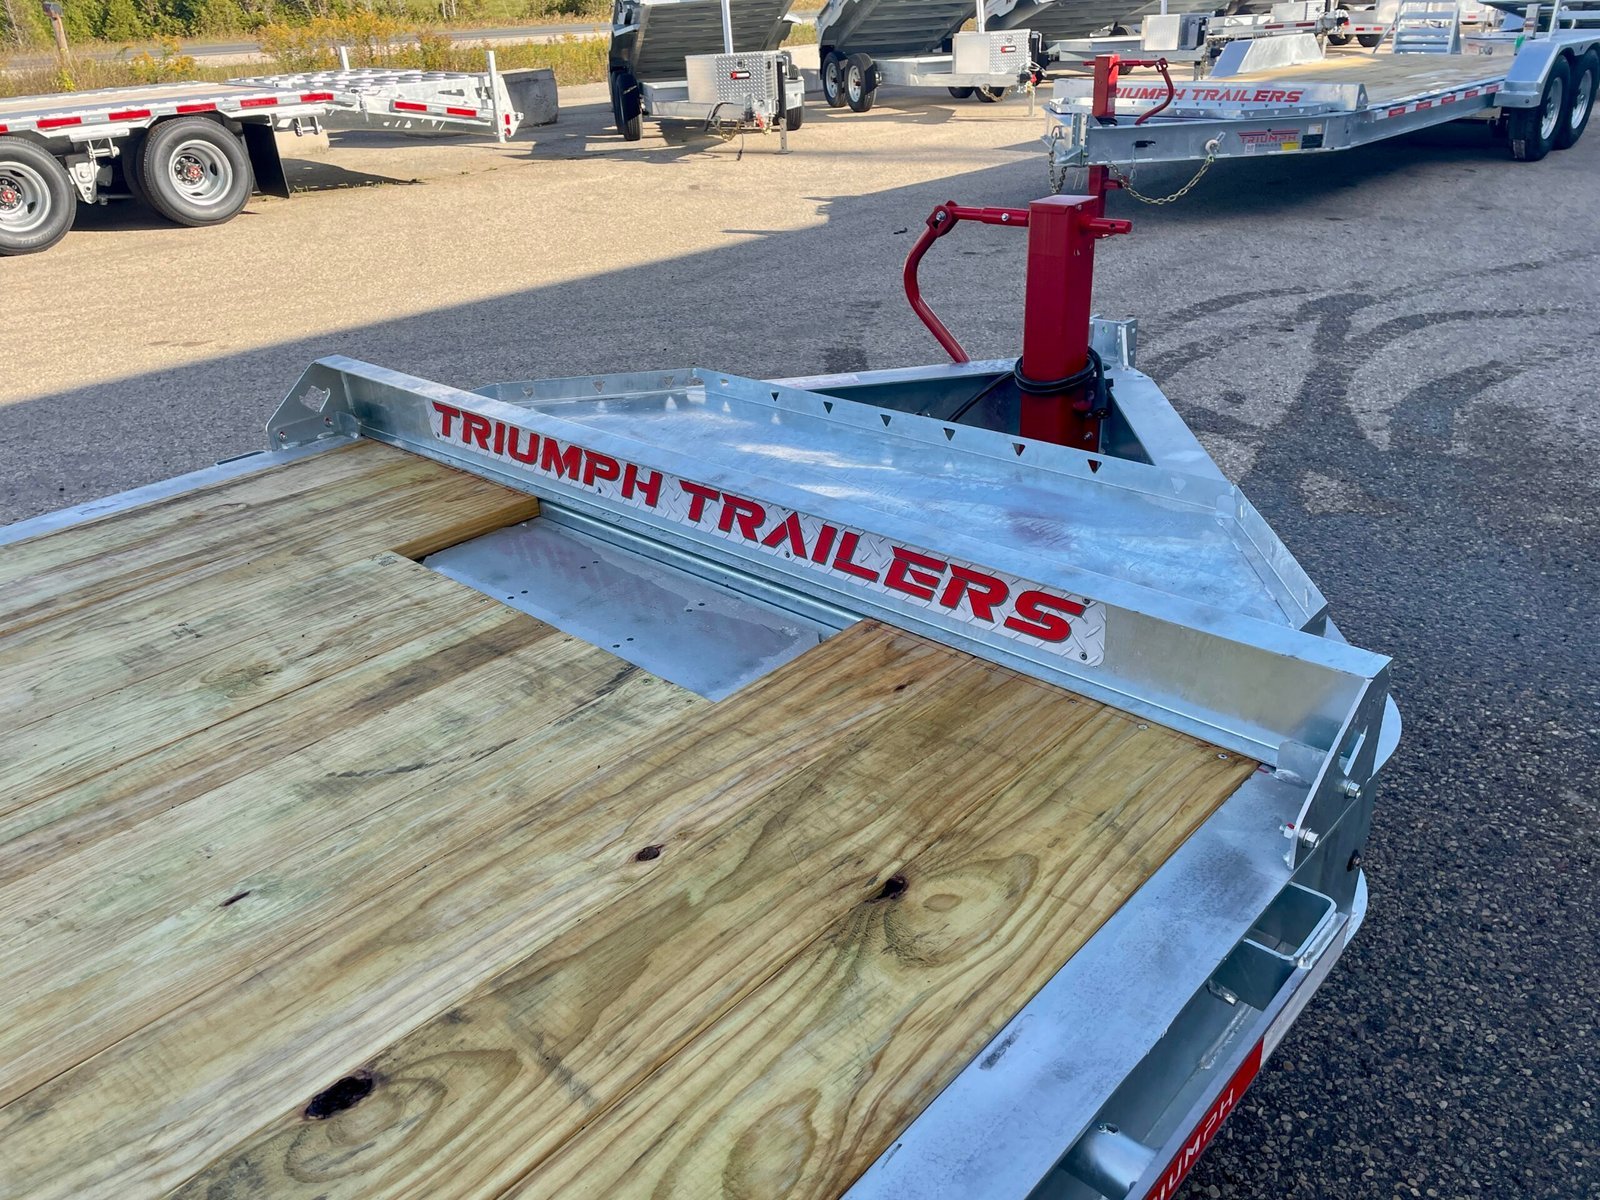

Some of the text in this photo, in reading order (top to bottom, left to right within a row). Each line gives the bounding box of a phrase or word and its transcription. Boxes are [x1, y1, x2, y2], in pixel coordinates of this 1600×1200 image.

[1114, 87, 1304, 103] IUMPH TRAILERS
[432, 401, 1087, 643] TRIUMPH TRAILERS
[1152, 1088, 1234, 1200] IUMPH
